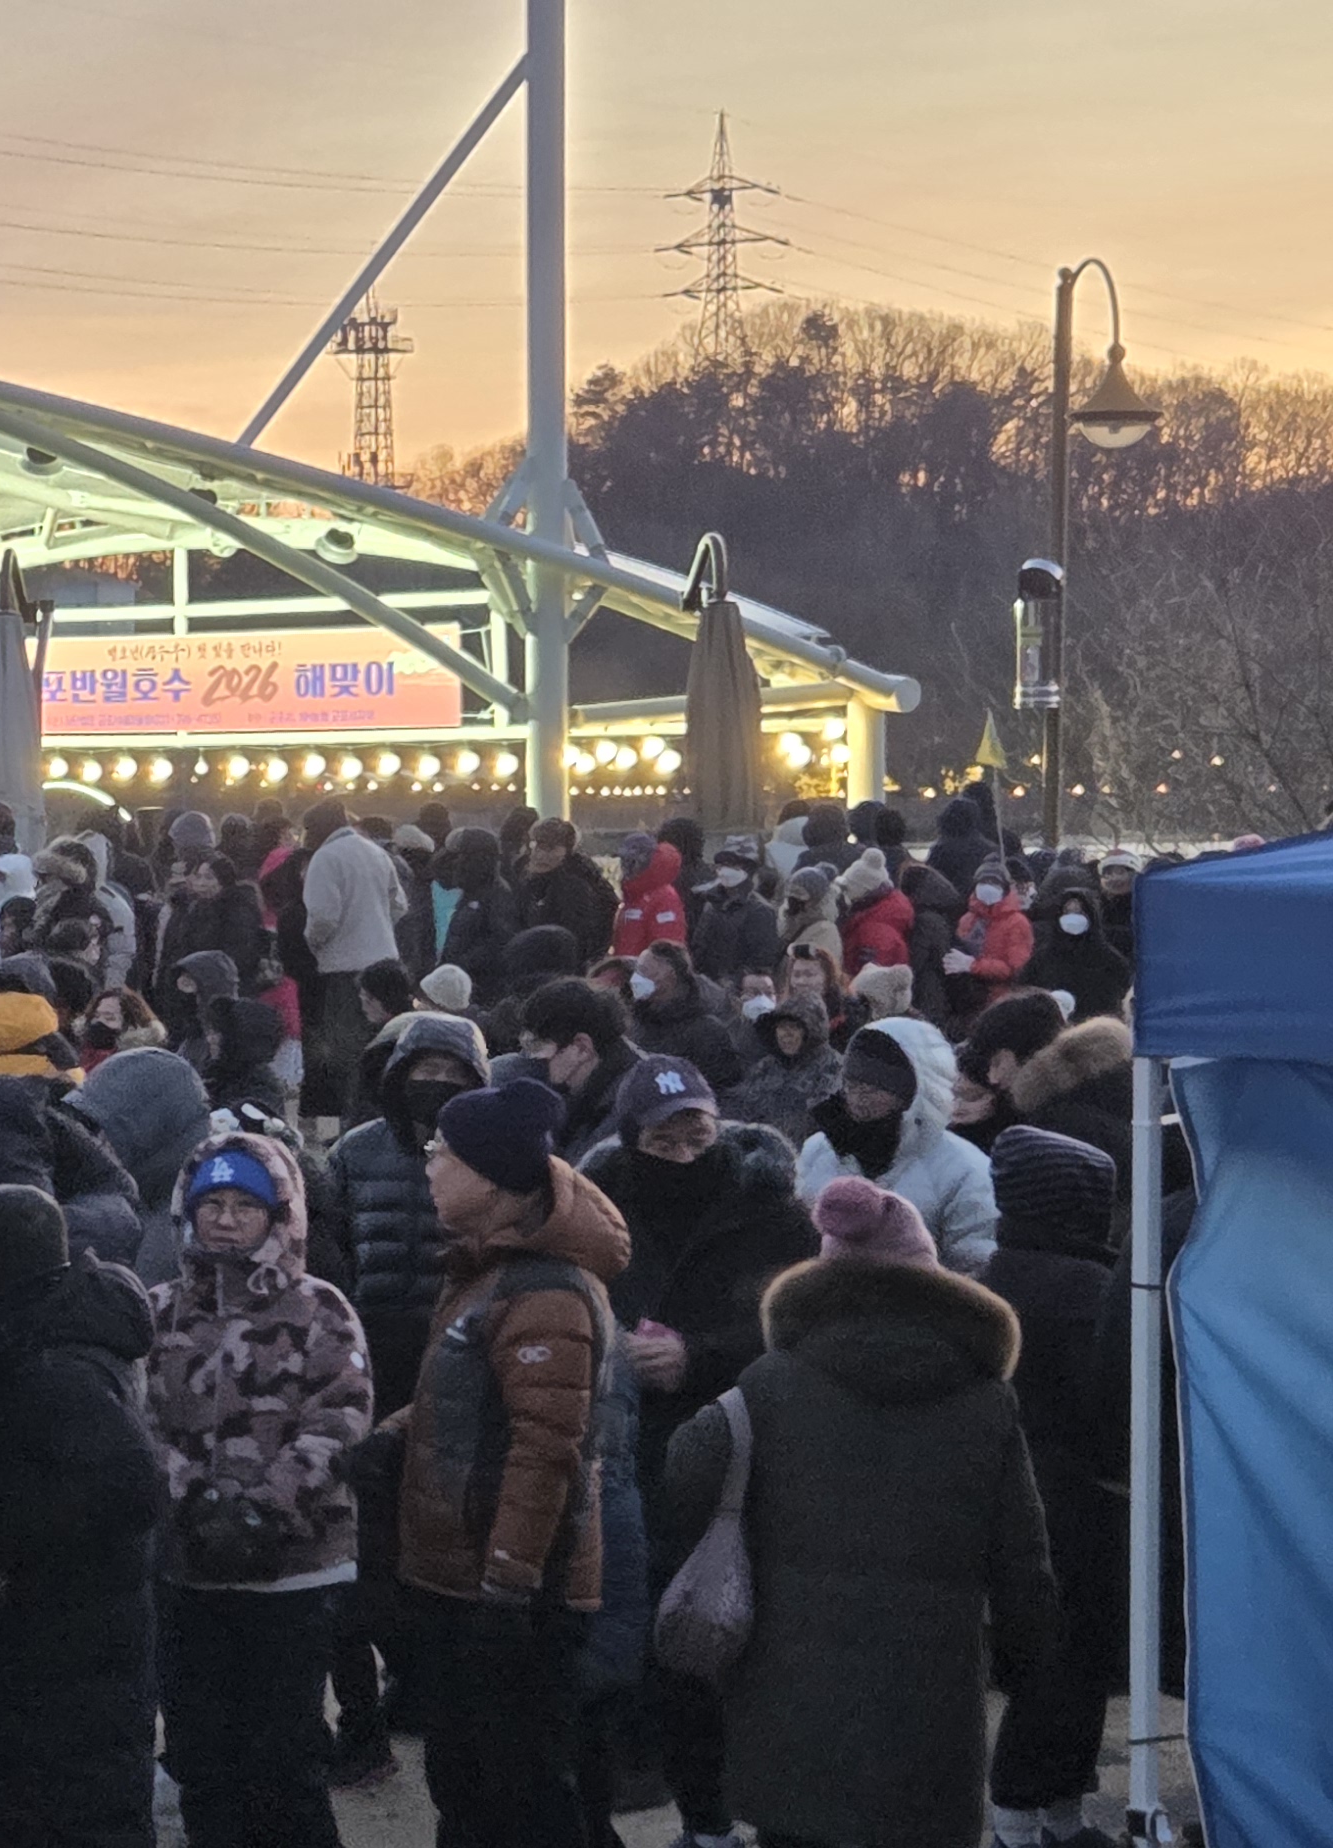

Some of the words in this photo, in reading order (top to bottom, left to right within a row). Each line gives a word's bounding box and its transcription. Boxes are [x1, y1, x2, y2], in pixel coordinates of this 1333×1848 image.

[201, 661, 279, 707] 2026
[294, 661, 394, 697] 해맞이
[654, 1071, 685, 1094] NY
[210, 1156, 234, 1183] LA
